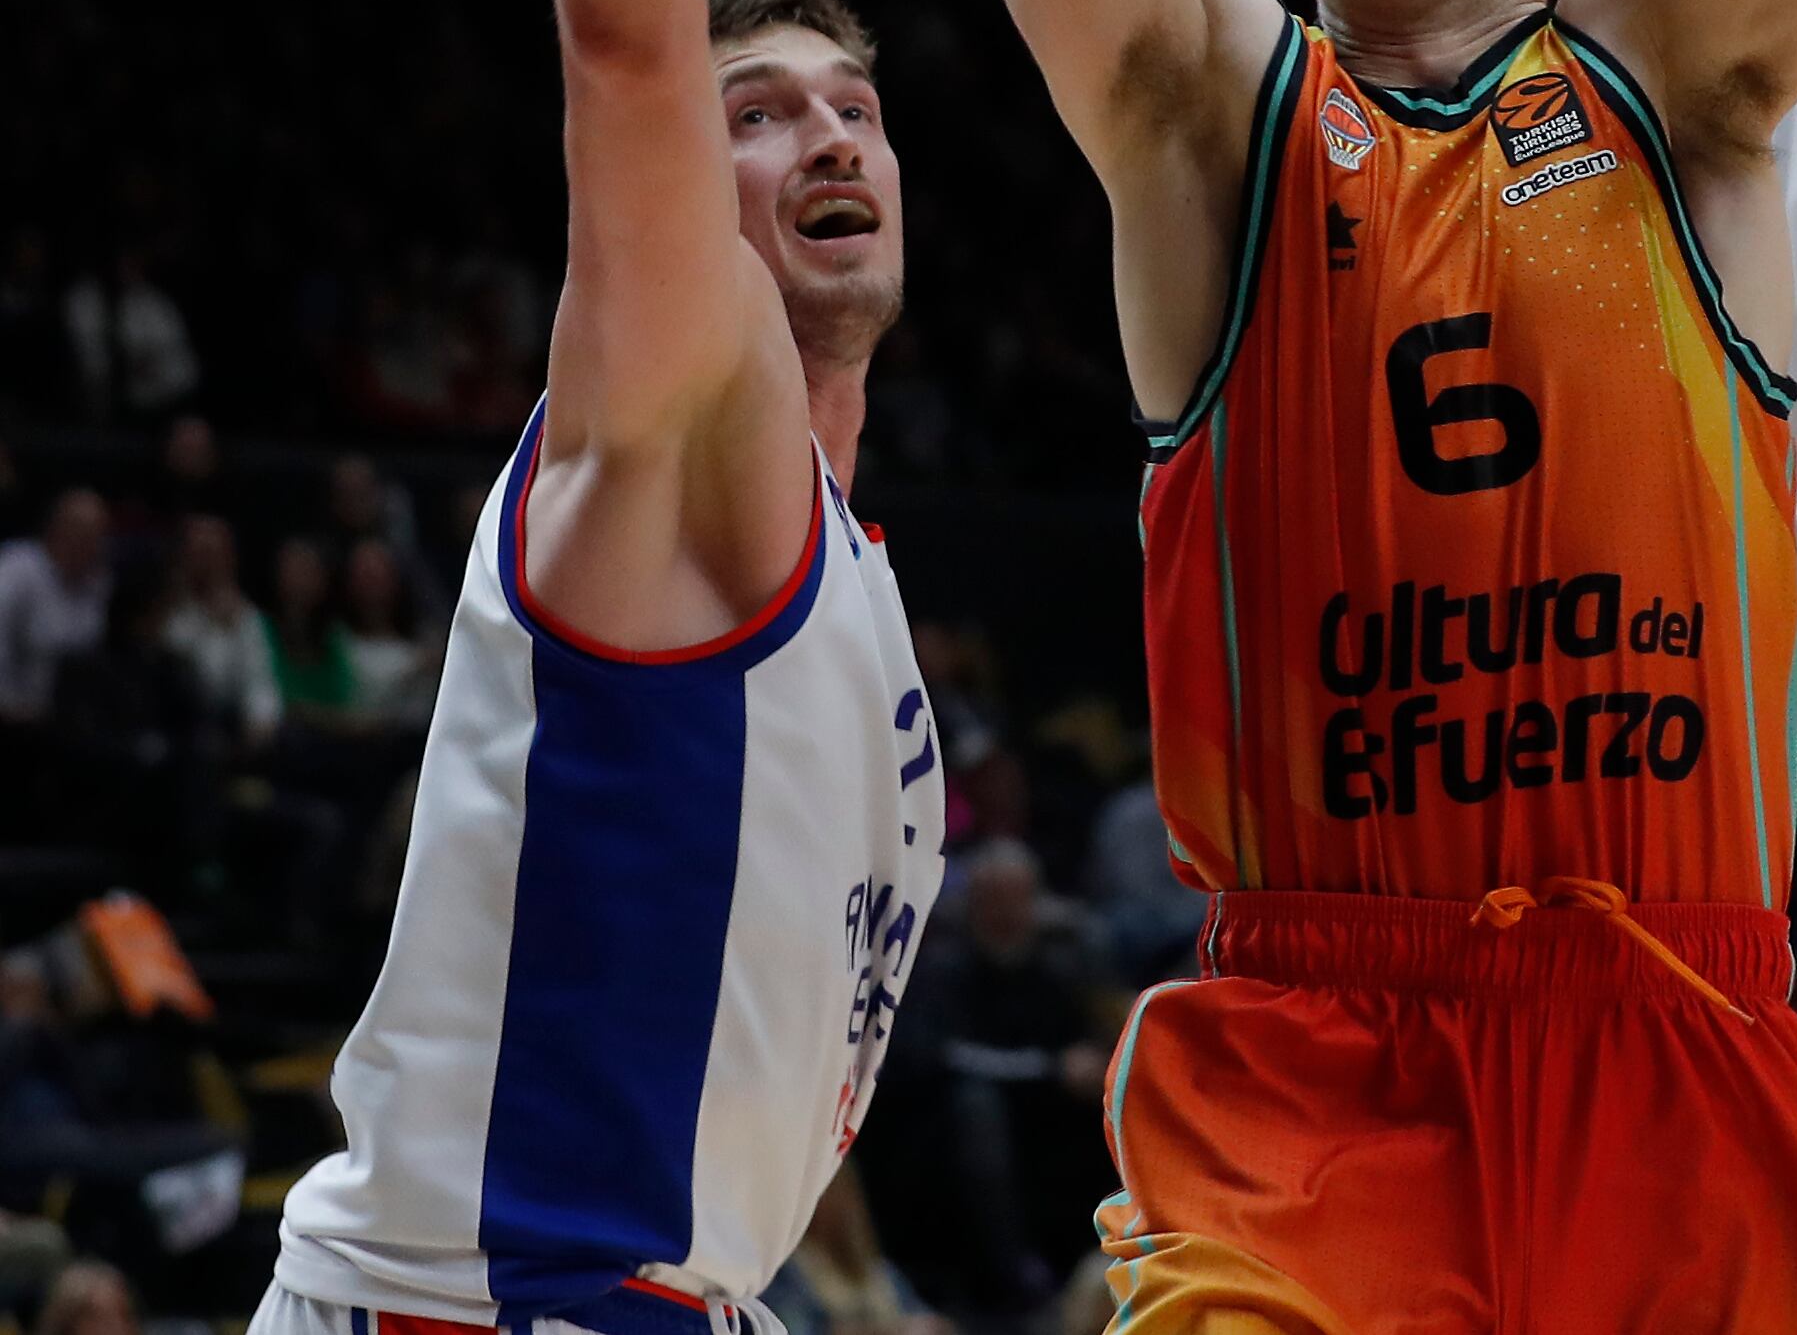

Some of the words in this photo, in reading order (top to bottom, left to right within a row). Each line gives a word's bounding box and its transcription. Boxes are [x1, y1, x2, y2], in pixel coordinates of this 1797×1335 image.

[1508, 110, 1578, 146] TURKISH
[1513, 119, 1582, 155] AIRLINES
[1505, 151, 1615, 202] oneteam
[1385, 311, 1541, 496] 6
[1630, 596, 1704, 659] del
